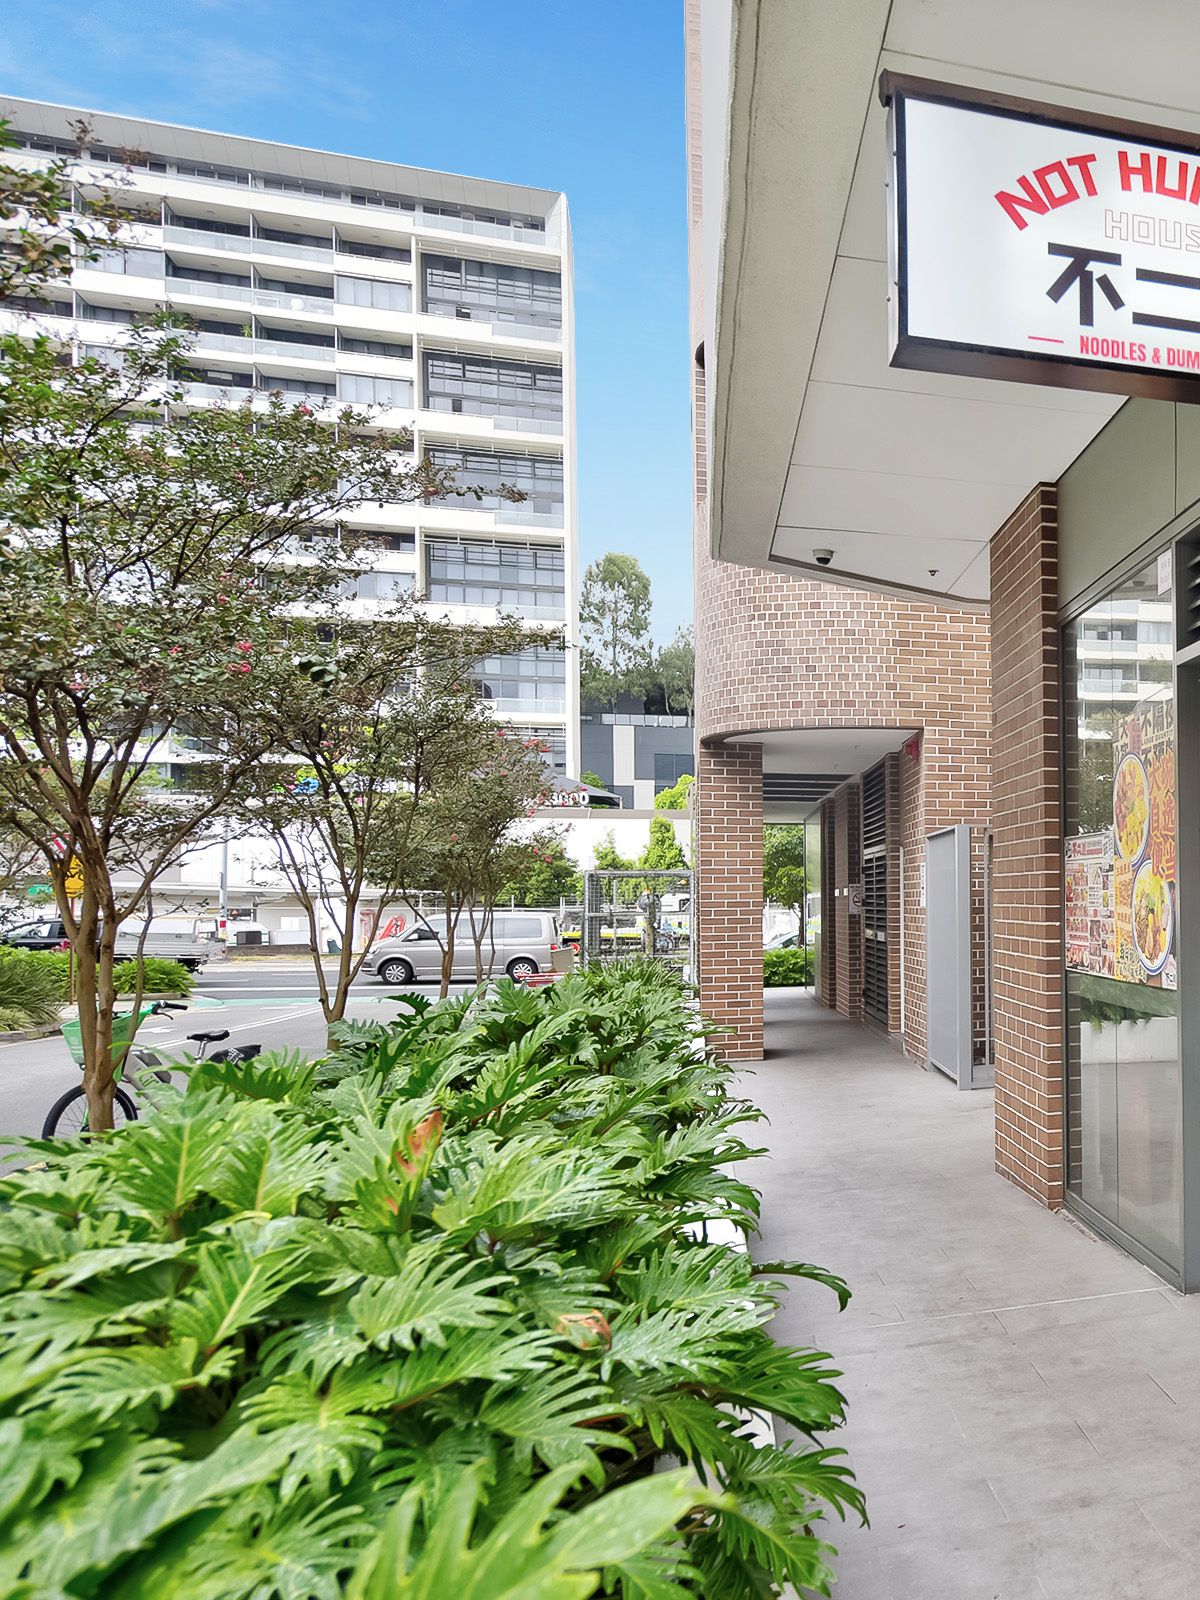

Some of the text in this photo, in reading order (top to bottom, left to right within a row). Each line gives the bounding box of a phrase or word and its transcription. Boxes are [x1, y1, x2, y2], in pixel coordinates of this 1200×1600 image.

[994, 153, 1098, 231] NOT
[1079, 334, 1147, 363] NOODLES
[1151, 348, 1162, 365] &
